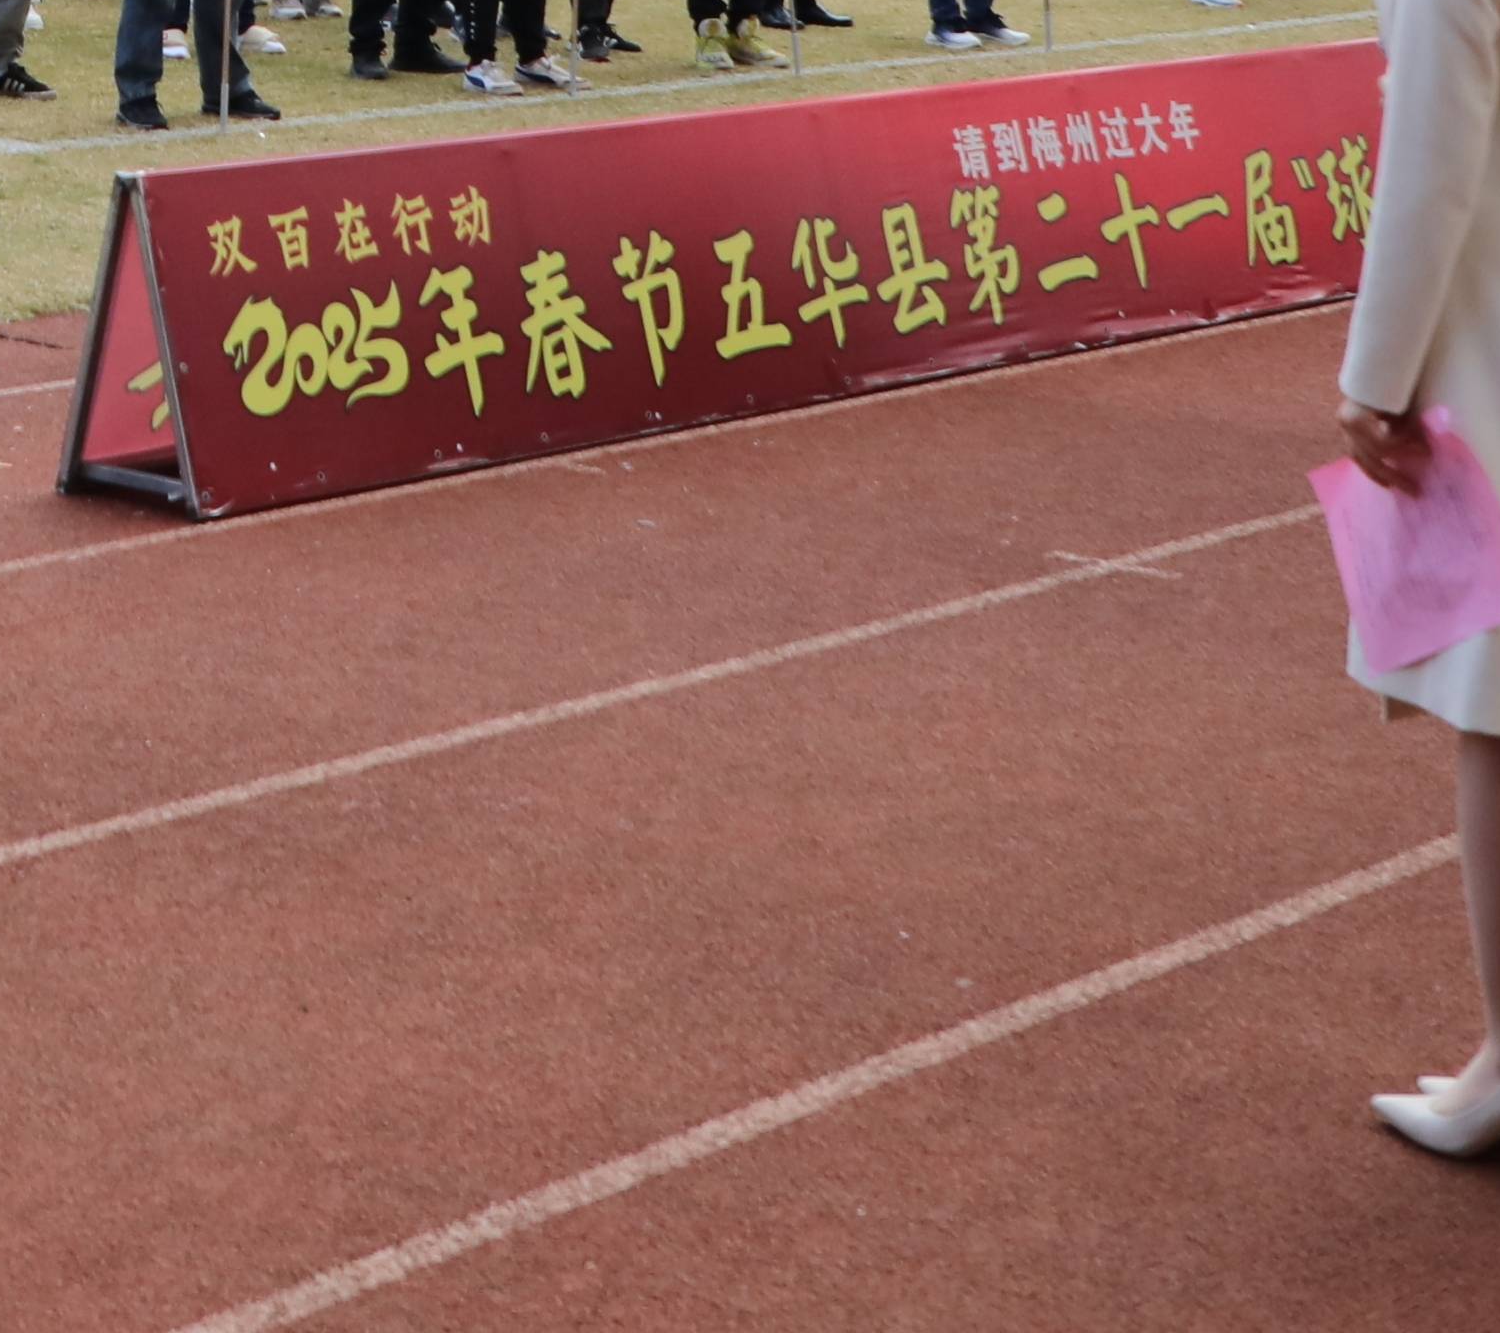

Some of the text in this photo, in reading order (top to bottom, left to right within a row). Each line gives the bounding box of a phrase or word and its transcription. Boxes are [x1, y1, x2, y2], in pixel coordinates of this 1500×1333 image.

[952, 99, 1200, 180] 请到梅州过大年
[206, 184, 493, 278] 双百在行动
